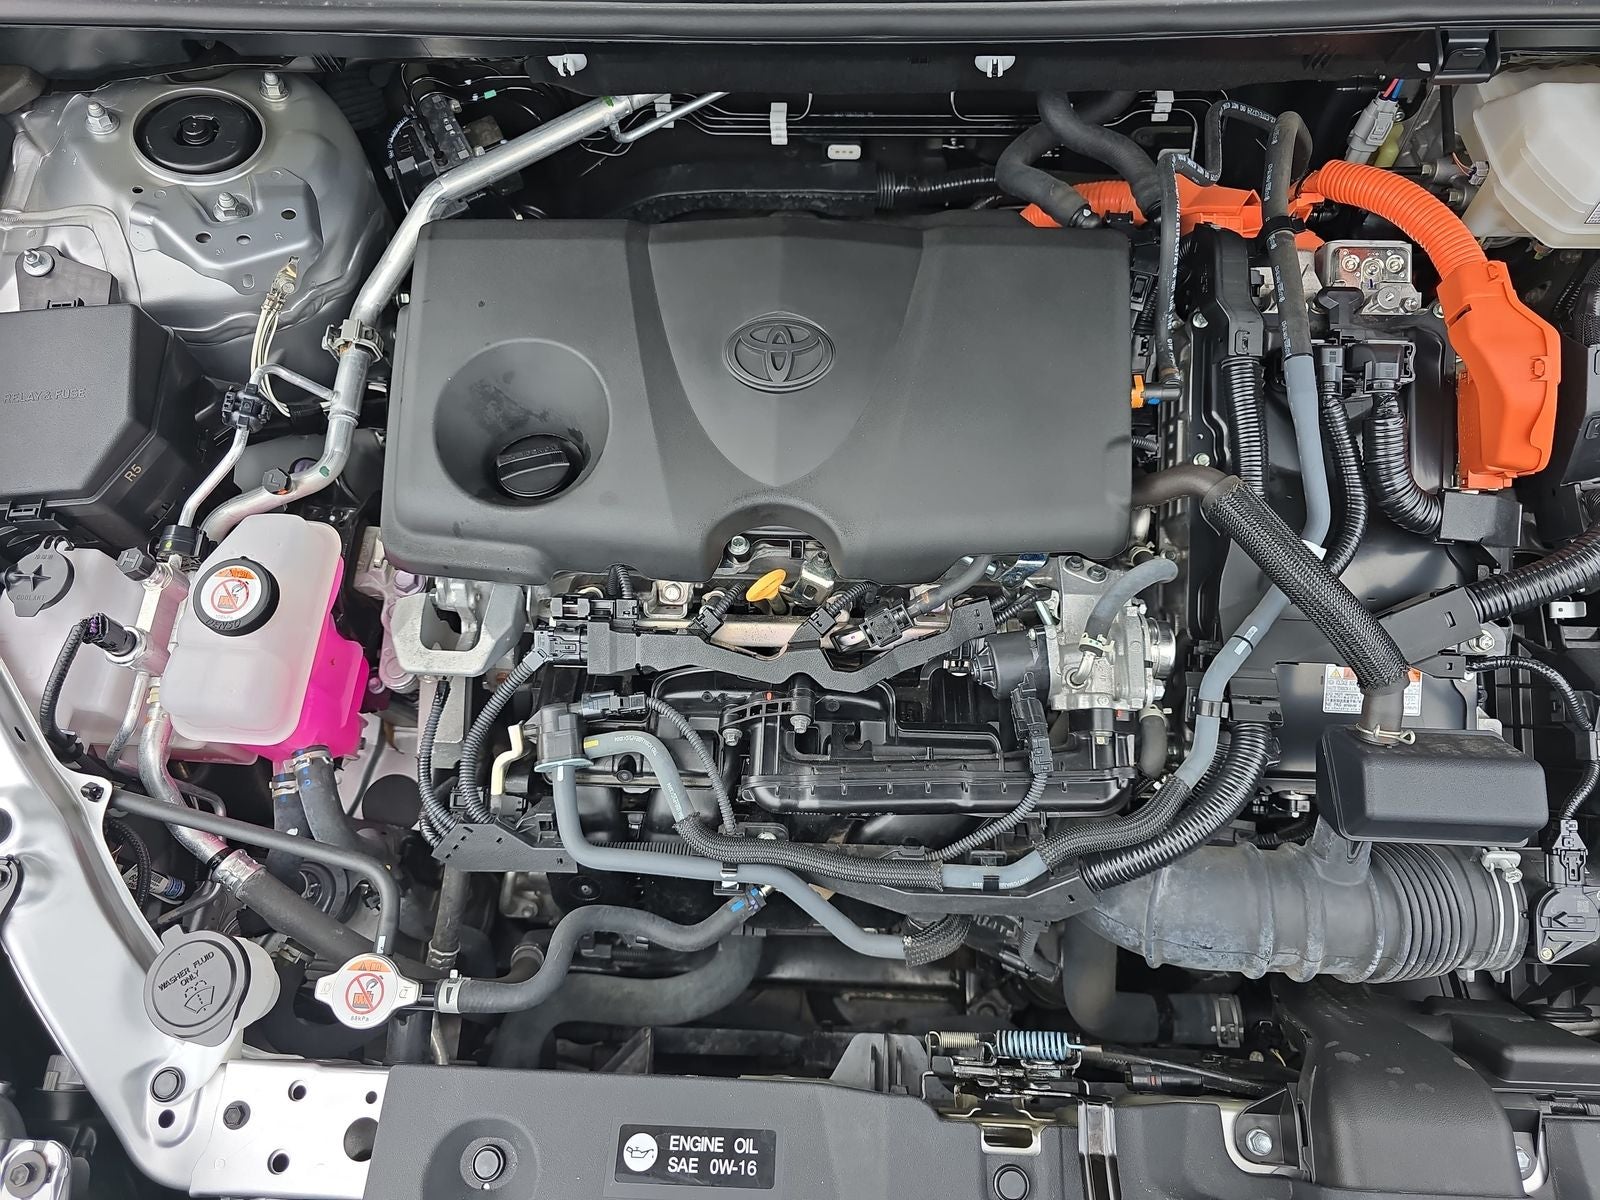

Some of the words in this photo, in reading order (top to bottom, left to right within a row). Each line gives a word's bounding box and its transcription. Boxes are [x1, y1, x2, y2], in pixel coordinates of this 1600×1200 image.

[4, 391, 42, 404] RELAY
[55, 387, 87, 401] FUSE
[124, 464, 142, 482] R5
[205, 619, 242, 631] DENSO
[157, 966, 191, 992] WASHER
[192, 951, 215, 969] FLUID
[180, 970, 200, 987] ONLY
[669, 1135, 725, 1153] ENGINE
[733, 1137, 759, 1155] OIL
[667, 1156, 699, 1174] SAE
[709, 1158, 758, 1176] 0W-16
